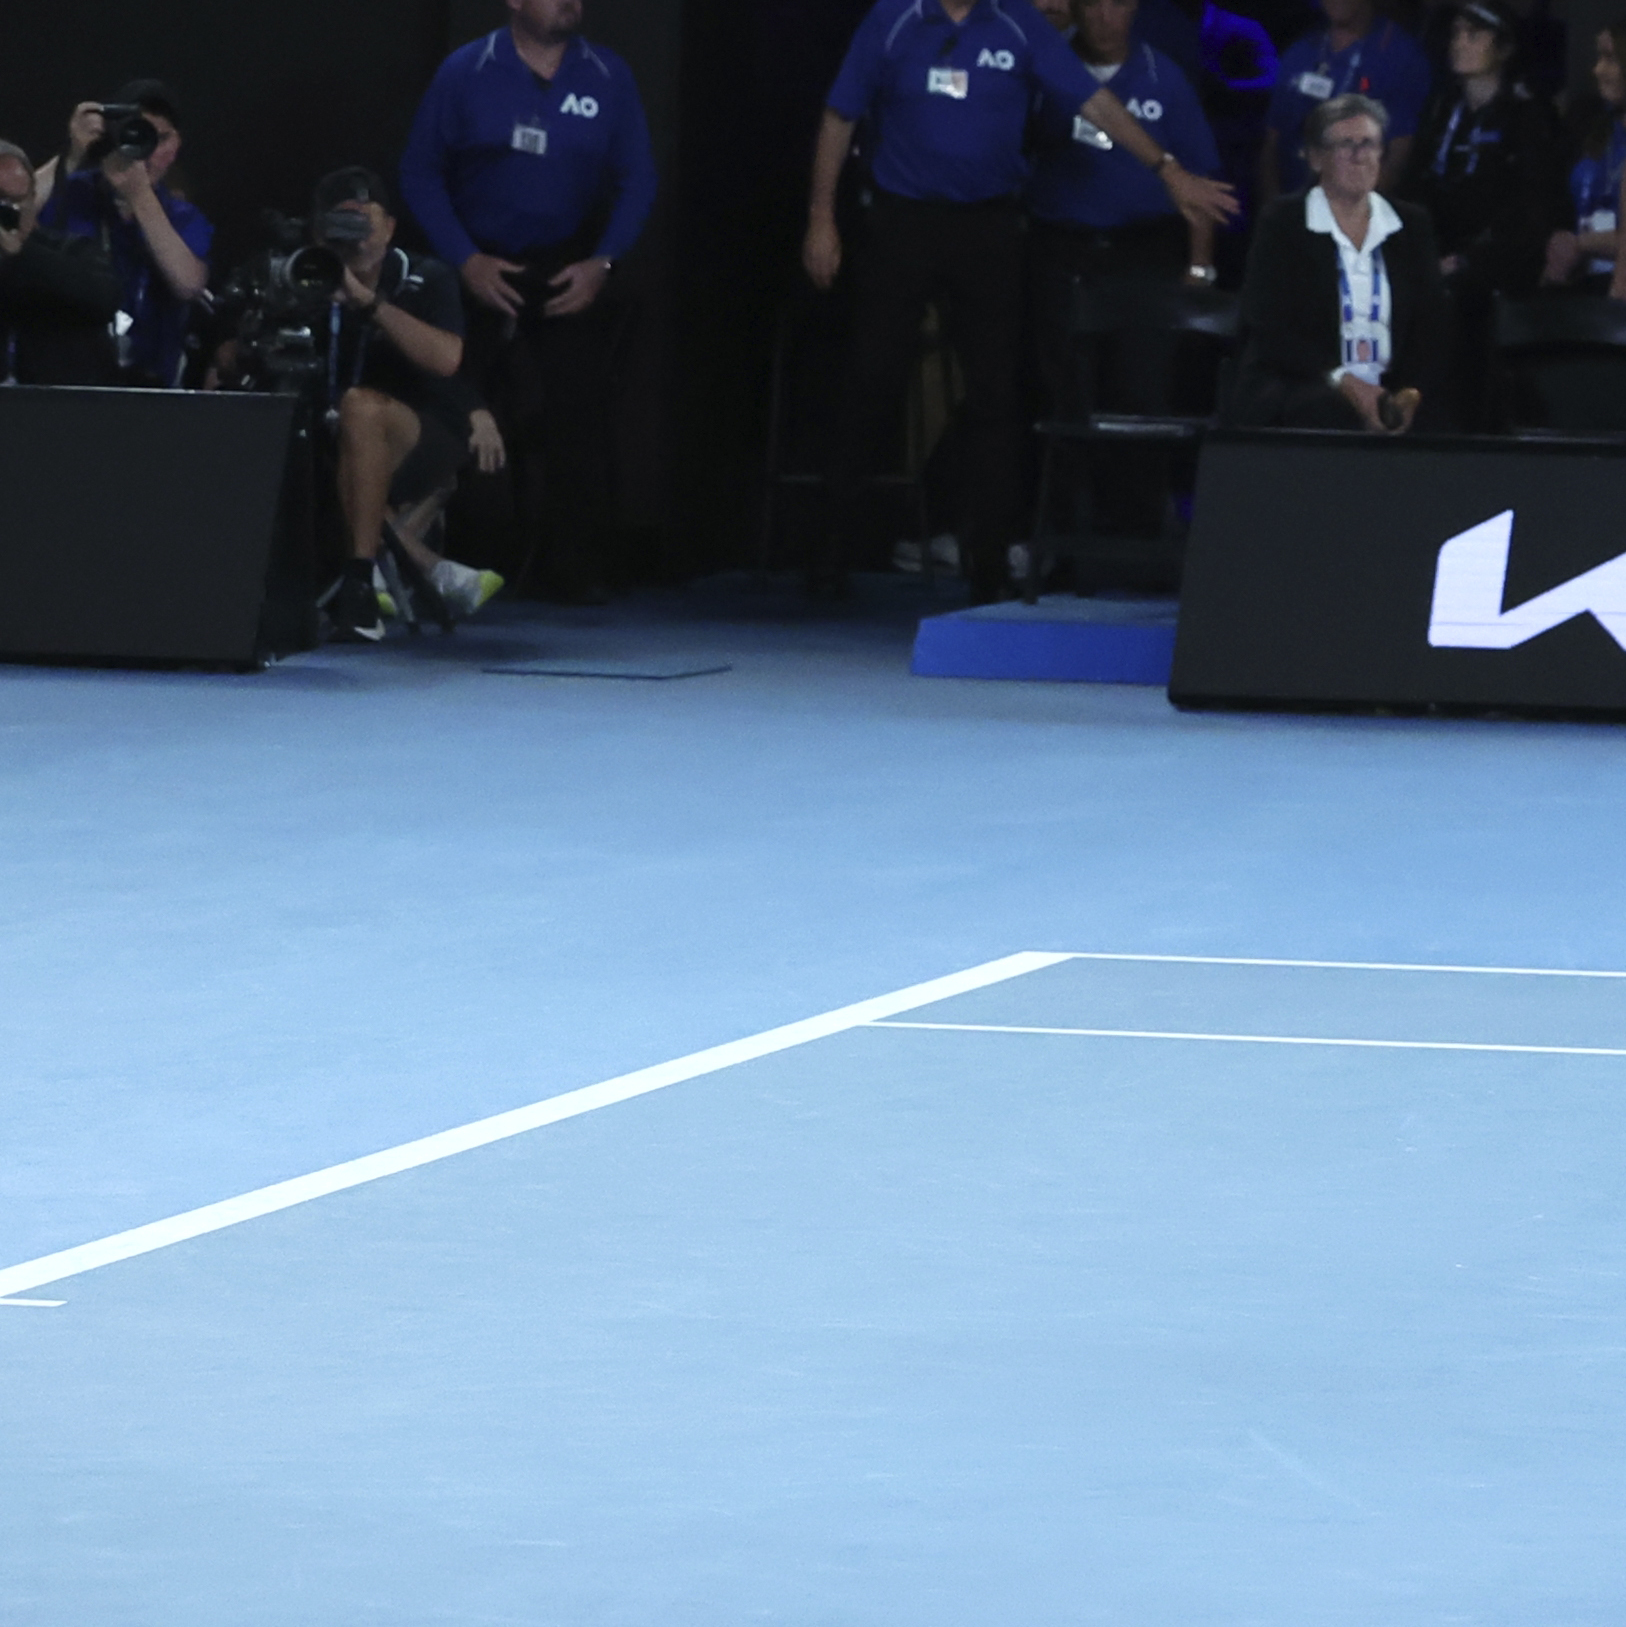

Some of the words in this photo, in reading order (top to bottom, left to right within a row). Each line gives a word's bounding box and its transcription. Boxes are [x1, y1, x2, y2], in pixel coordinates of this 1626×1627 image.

[978, 48, 1014, 71] AO
[560, 93, 599, 119] AO
[1127, 98, 1162, 120] AO
